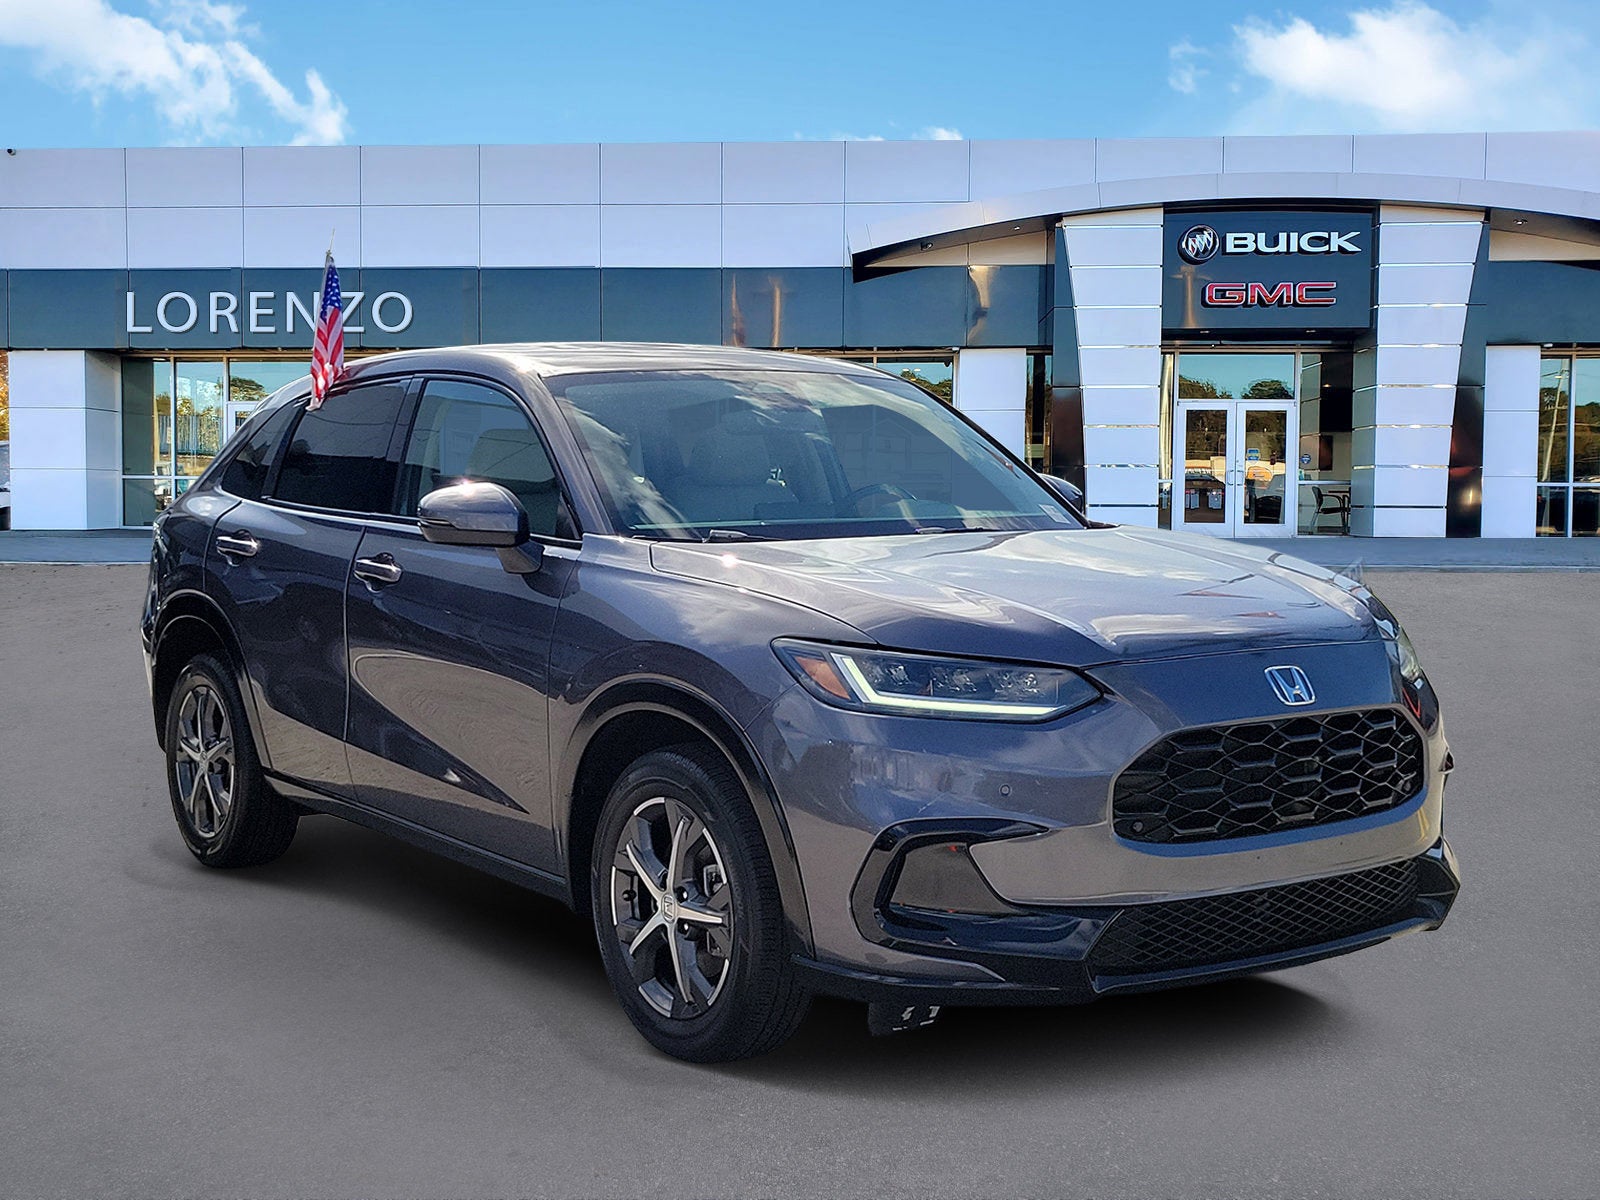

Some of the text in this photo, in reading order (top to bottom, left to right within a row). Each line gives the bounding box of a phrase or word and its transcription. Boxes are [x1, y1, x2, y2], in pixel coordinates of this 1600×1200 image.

[1225, 231, 1362, 253] BUICK
[1205, 282, 1337, 305] GMC
[126, 291, 413, 333] LORENZO
